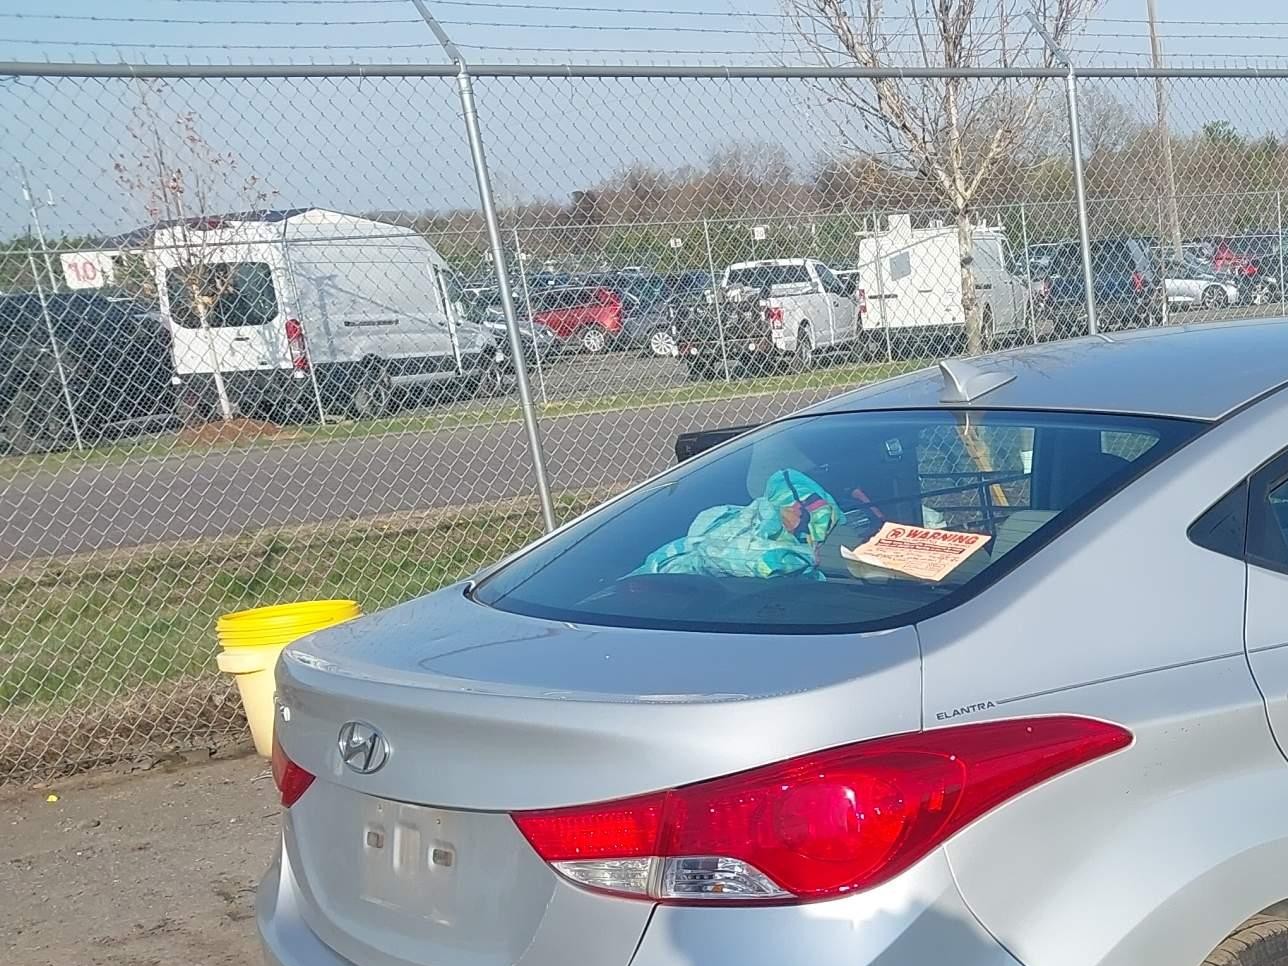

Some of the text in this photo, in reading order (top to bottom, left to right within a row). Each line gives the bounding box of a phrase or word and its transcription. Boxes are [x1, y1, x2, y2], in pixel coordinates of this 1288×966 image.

[68, 262, 97, 281] 10
[906, 529, 979, 545] WARNING
[936, 701, 996, 720] ELANTRA
